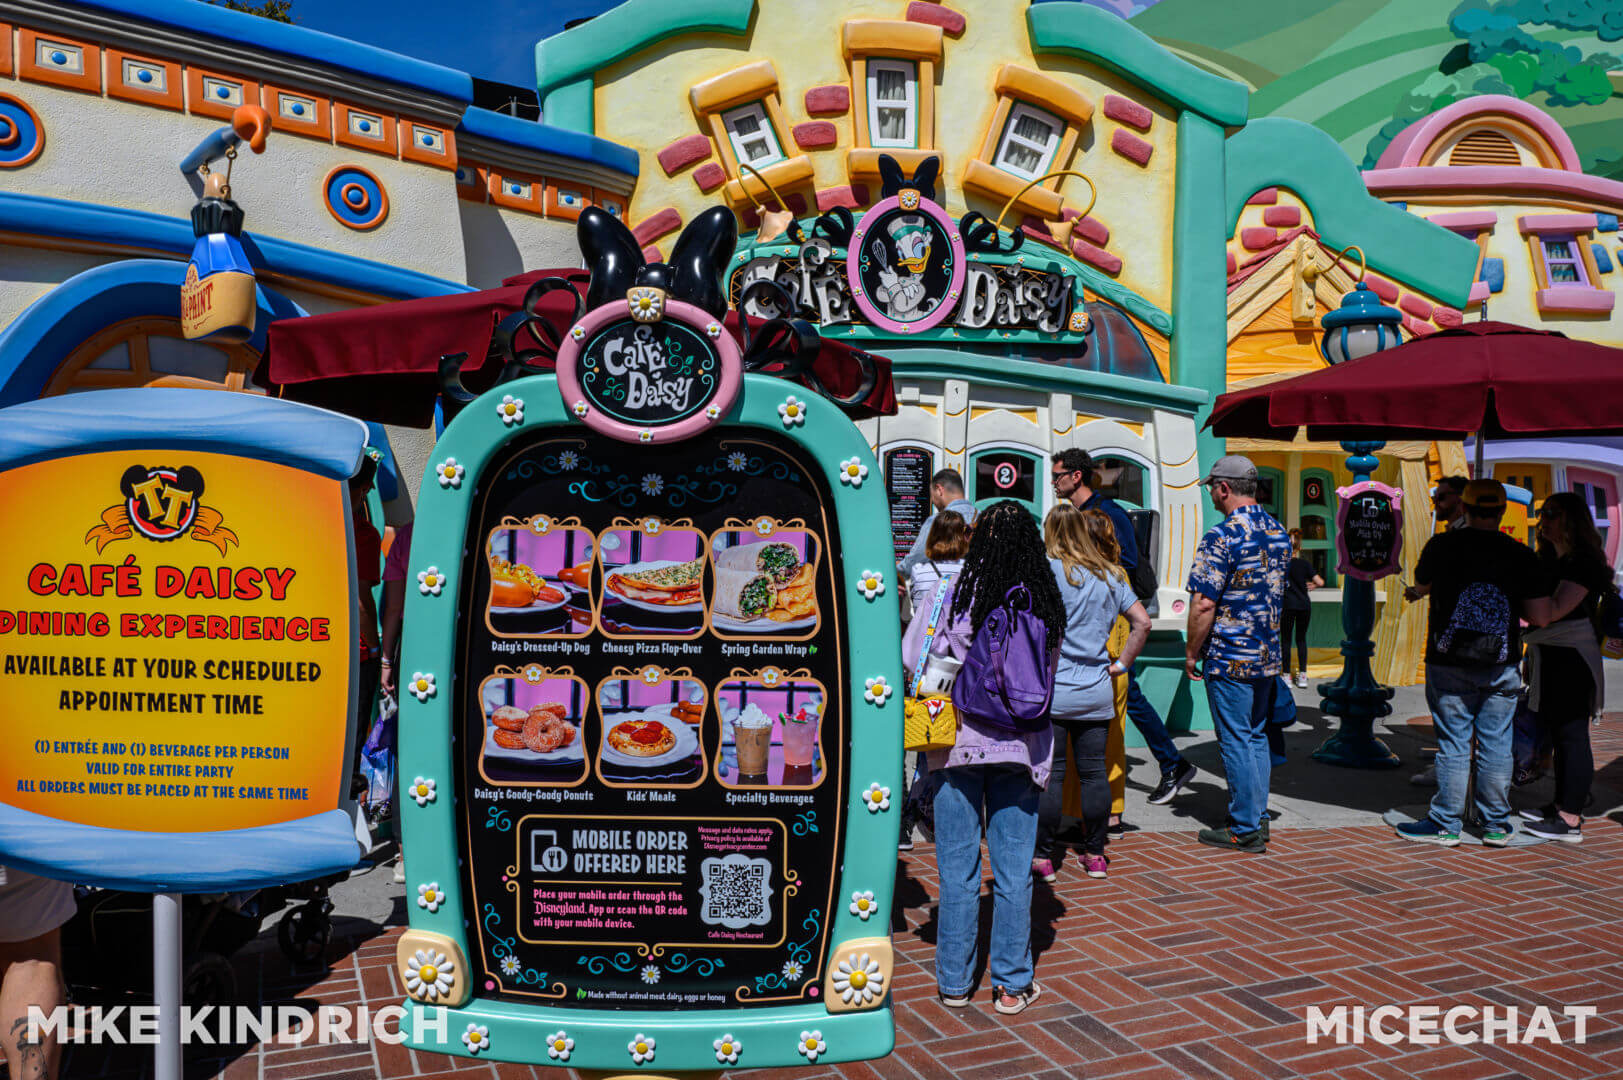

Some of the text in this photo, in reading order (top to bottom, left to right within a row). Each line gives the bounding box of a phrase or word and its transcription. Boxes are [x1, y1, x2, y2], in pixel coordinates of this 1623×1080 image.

[954, 261, 1076, 334] Daisy
[624, 371, 694, 412] Daisy
[1000, 467, 1010, 483] 2
[1309, 485, 1317, 497] 4
[28, 554, 296, 600] CAFÉ DAISY
[0, 610, 330, 641] DINING EXPERIENCE
[491, 640, 590, 655] Daisy's Dressed-Up Dog
[602, 642, 703, 656] Cheesy Pizza Flop-Over
[721, 643, 808, 657] Spring Garden Wrap
[4, 655, 321, 682] AVAILABLE AT YOUR SCHEDULED
[59, 690, 264, 715] APPOINTMENT TIME
[53, 738, 99, 754] ENTRÉE
[102, 742, 127, 755] AND
[149, 744, 211, 758] BEVERAGE
[215, 745, 238, 759] PER
[241, 746, 290, 760] PERSON
[86, 761, 234, 778] VALID FOR ENTIRE PARTY
[16, 779, 309, 800] ALL ORDERS MUST BE PLACED AT THE SAME TIME
[474, 788, 594, 803] Daisy's Goody-Goody Donuts
[626, 790, 677, 802] Kids' Meals
[726, 791, 815, 806] Specialty Beverages
[698, 826, 720, 835] Message
[572, 830, 688, 850] MOBILE ORDER
[701, 834, 720, 843] Privacy
[721, 835, 735, 843] policy
[574, 854, 687, 875] OFFERED HERE
[533, 888, 683, 903] Place your mobile order through the
[588, 903, 605, 916] App
[606, 906, 615, 914] or
[617, 906, 636, 914] scan
[638, 904, 653, 914] the
[655, 905, 666, 915] QR
[668, 905, 688, 915] code
[533, 917, 635, 929] with your mobile device.
[721, 931, 735, 940] Daisy
[588, 991, 604, 999] Made
[605, 991, 628, 999] without
[629, 992, 648, 1000] animal
[667, 992, 683, 1002] dairy,
[684, 994, 699, 1003] eggs
[707, 993, 726, 1003] honey
